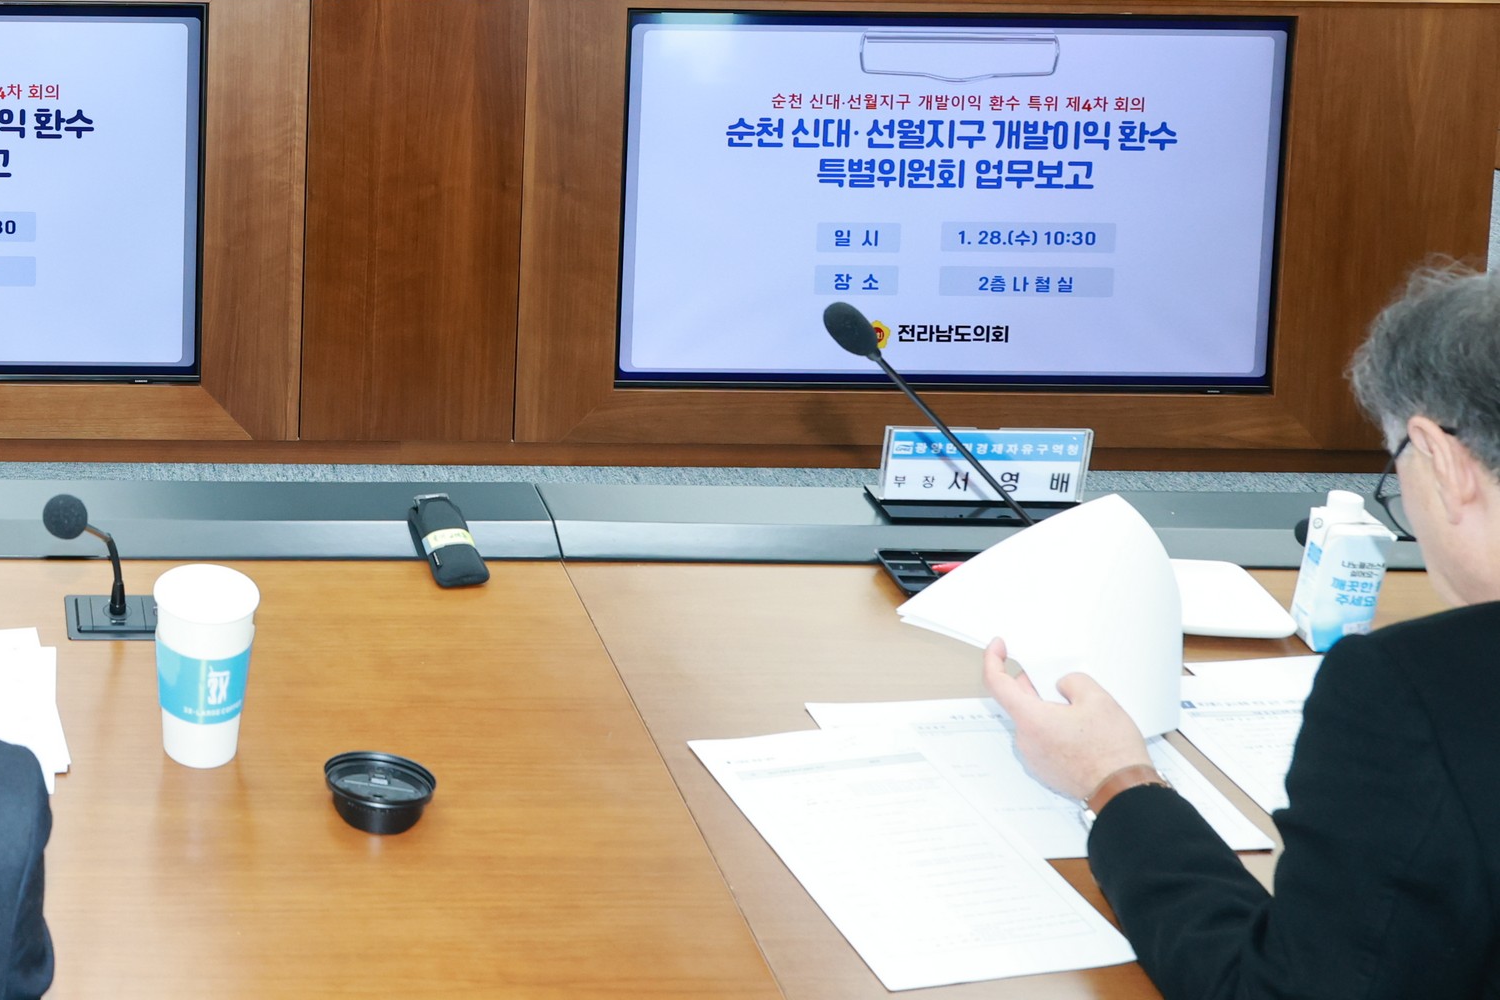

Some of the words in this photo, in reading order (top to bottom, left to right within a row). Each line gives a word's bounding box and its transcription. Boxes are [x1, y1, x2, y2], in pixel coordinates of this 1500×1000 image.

[28, 84, 58, 100] 회의
[772, 94, 802, 109] 순천
[810, 94, 910, 110] 신대·선월지구
[919, 95, 981, 110] 개발이익
[989, 96, 1020, 111] 환수
[1028, 96, 1057, 111] 특위
[1066, 96, 1108, 112] 제4차
[1114, 97, 1144, 112] 회의
[34, 109, 94, 139] 환수
[726, 118, 783, 147] 순천
[993, 121, 1110, 150] 개발이익
[1118, 121, 1177, 151] 환수
[817, 159, 965, 188] 특별위원회
[976, 160, 1094, 189] 업무보고
[959, 231, 971, 244] 1.
[1045, 231, 1095, 245] 10:30
[979, 276, 1005, 292] 2층
[898, 325, 1009, 343] 전라남도의회
[1050, 473, 1070, 493] 배
